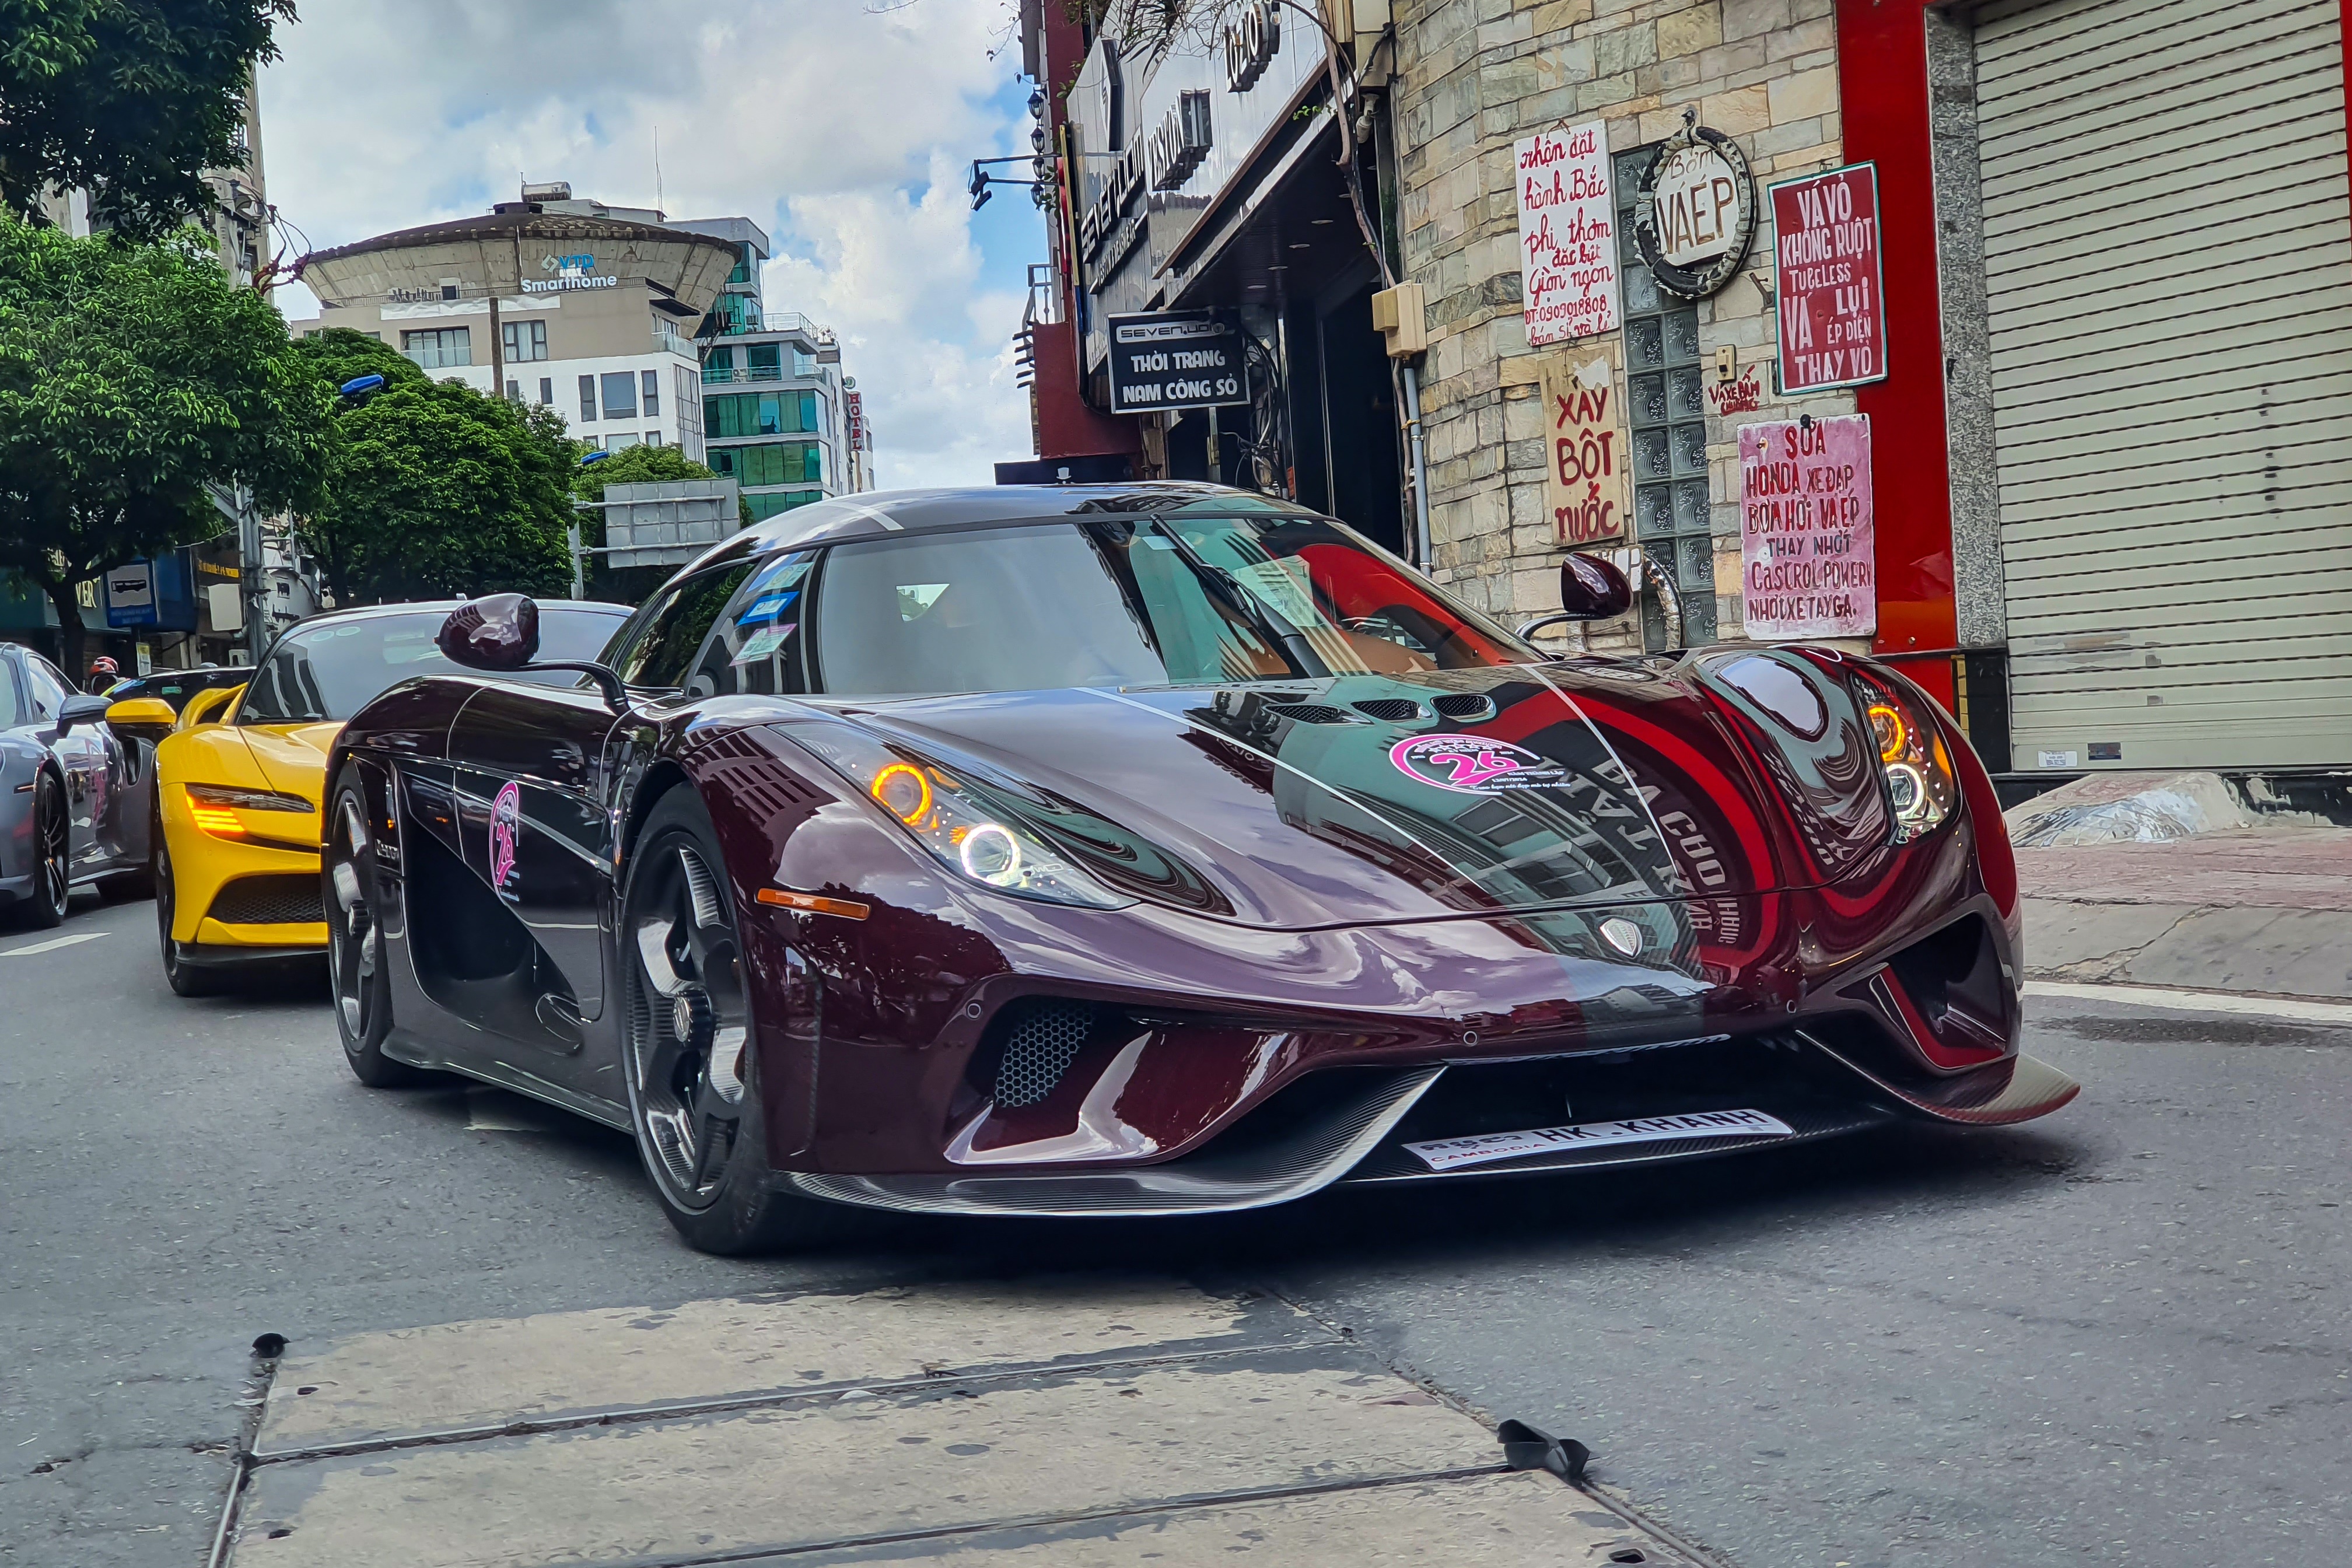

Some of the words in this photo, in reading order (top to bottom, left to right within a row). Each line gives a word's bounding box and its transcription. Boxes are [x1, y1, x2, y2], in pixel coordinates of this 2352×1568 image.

[1569, 129, 1597, 160] đặt
[1524, 169, 1567, 211] hành
[1569, 164, 1608, 201] Bắc
[1797, 180, 1825, 229] VÁ
[1822, 173, 1852, 224] VỎ
[1524, 213, 1558, 265] phi
[1567, 206, 1612, 244] thơm
[1782, 228, 1832, 268] KHÔNG
[1835, 216, 1872, 260] RUỘT
[1552, 247, 1577, 271] đặc
[522, 275, 618, 292] Smarthome
[1570, 265, 1615, 298] ngon
[1528, 326, 1554, 345] bán
[1574, 317, 1594, 336] và
[1783, 292, 1813, 351] VÁ
[1826, 316, 1843, 344] ÉP
[1130, 350, 1168, 372] THỜI
[1172, 349, 1226, 370] TRANG
[1794, 349, 1845, 384] THAY
[1849, 340, 1872, 377] VỎ
[1122, 383, 1161, 403] NAM
[1166, 378, 1212, 400] CÔNG
[848, 393, 863, 450] HOTEL
[1746, 461, 1801, 498] HONDA
[1766, 537, 1805, 557] THAY
[1787, 596, 1806, 620] XE
[1429, 751, 1520, 780] 26
[1431, 1143, 1546, 1162] CAMBODIA
